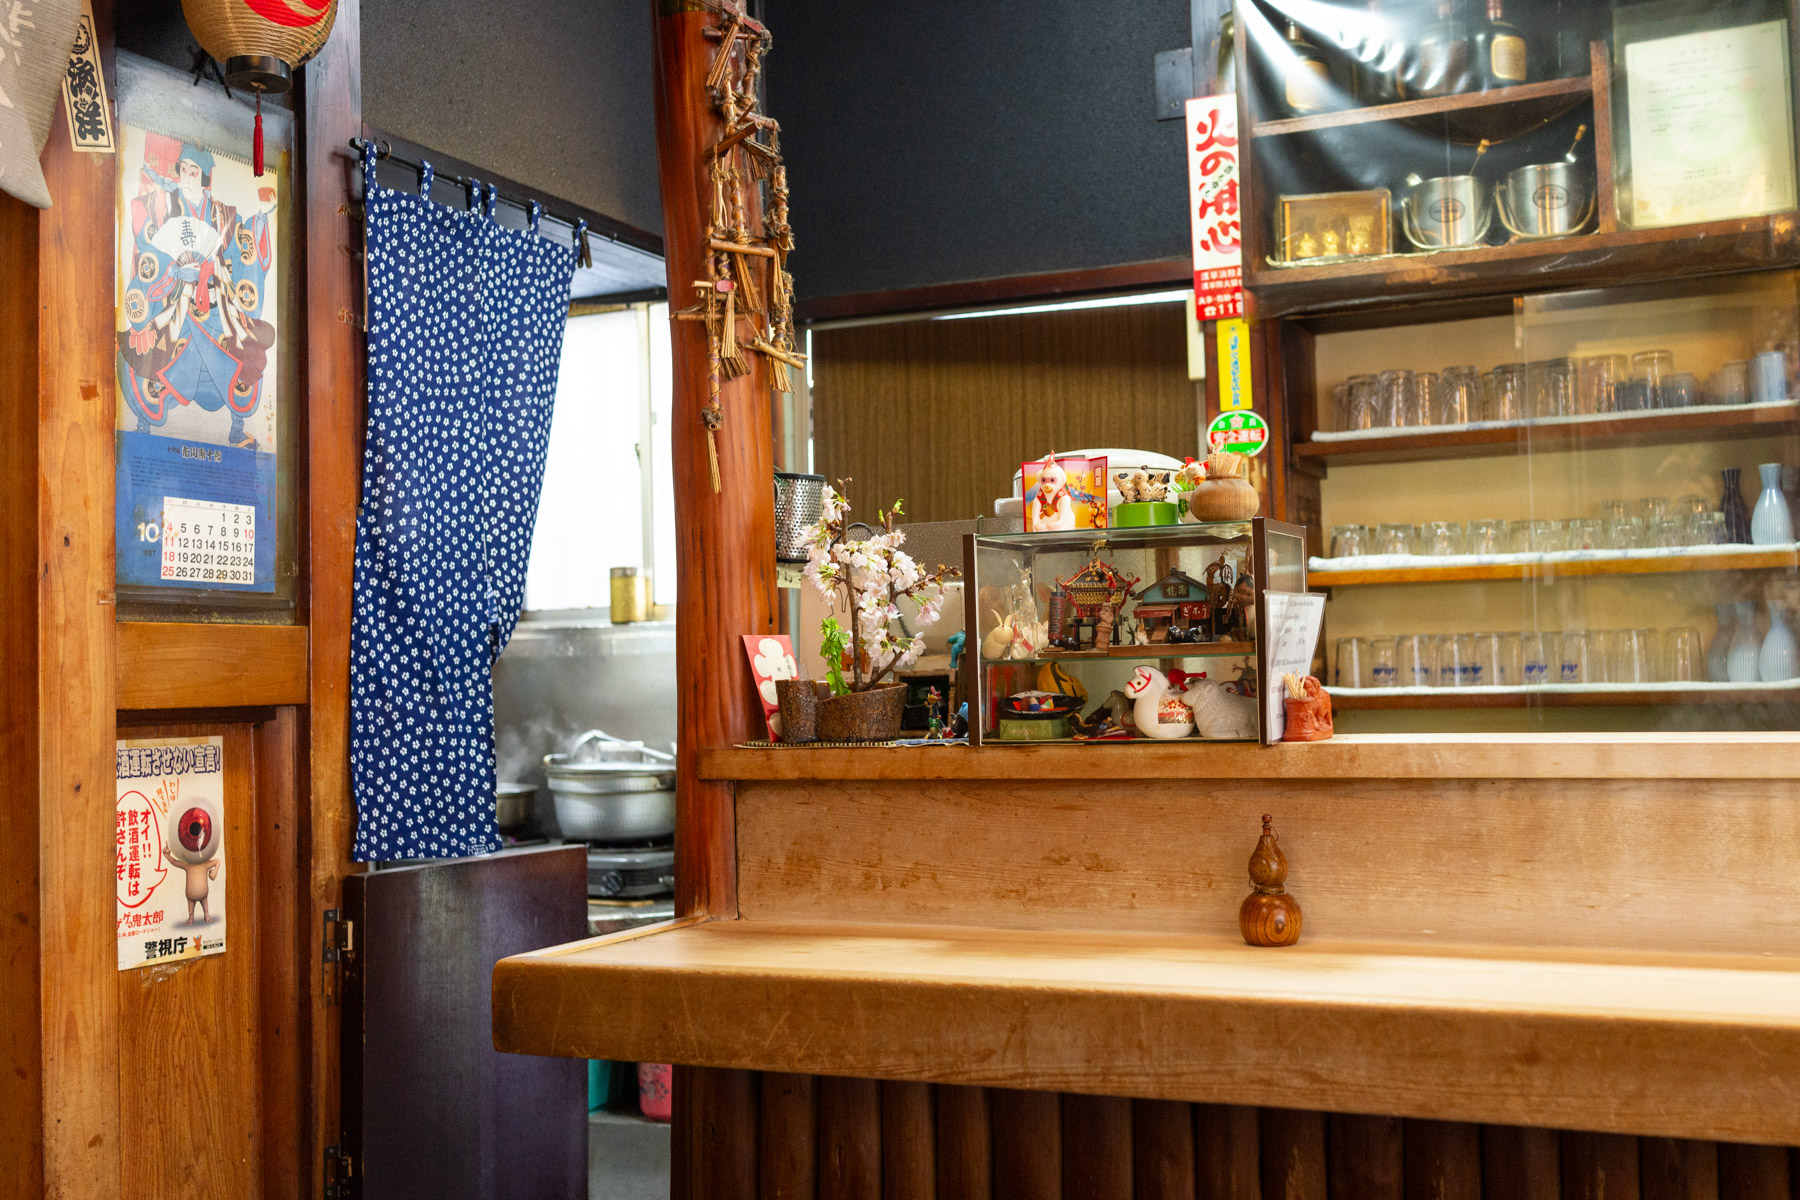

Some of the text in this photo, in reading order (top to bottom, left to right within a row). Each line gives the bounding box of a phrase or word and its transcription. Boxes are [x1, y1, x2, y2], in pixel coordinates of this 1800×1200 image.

[1196, 109, 1241, 254] 火の用心
[222, 513, 251, 525] 1 2 3
[137, 521, 160, 543] 10
[167, 522, 254, 539] 4 5 6 7 8 9 10
[165, 537, 254, 553] 11 12 13 14 15 16 17
[164, 552, 254, 567] 18 19 20 21 22 23 24
[162, 566, 252, 581] 25 26 27 28 29 30 31
[116, 745, 220, 780] 酒運転させない宣言!
[117, 811, 127, 880] 許さんぞ
[128, 809, 140, 897] 飲酒運転は
[144, 936, 188, 960] 警視庁
